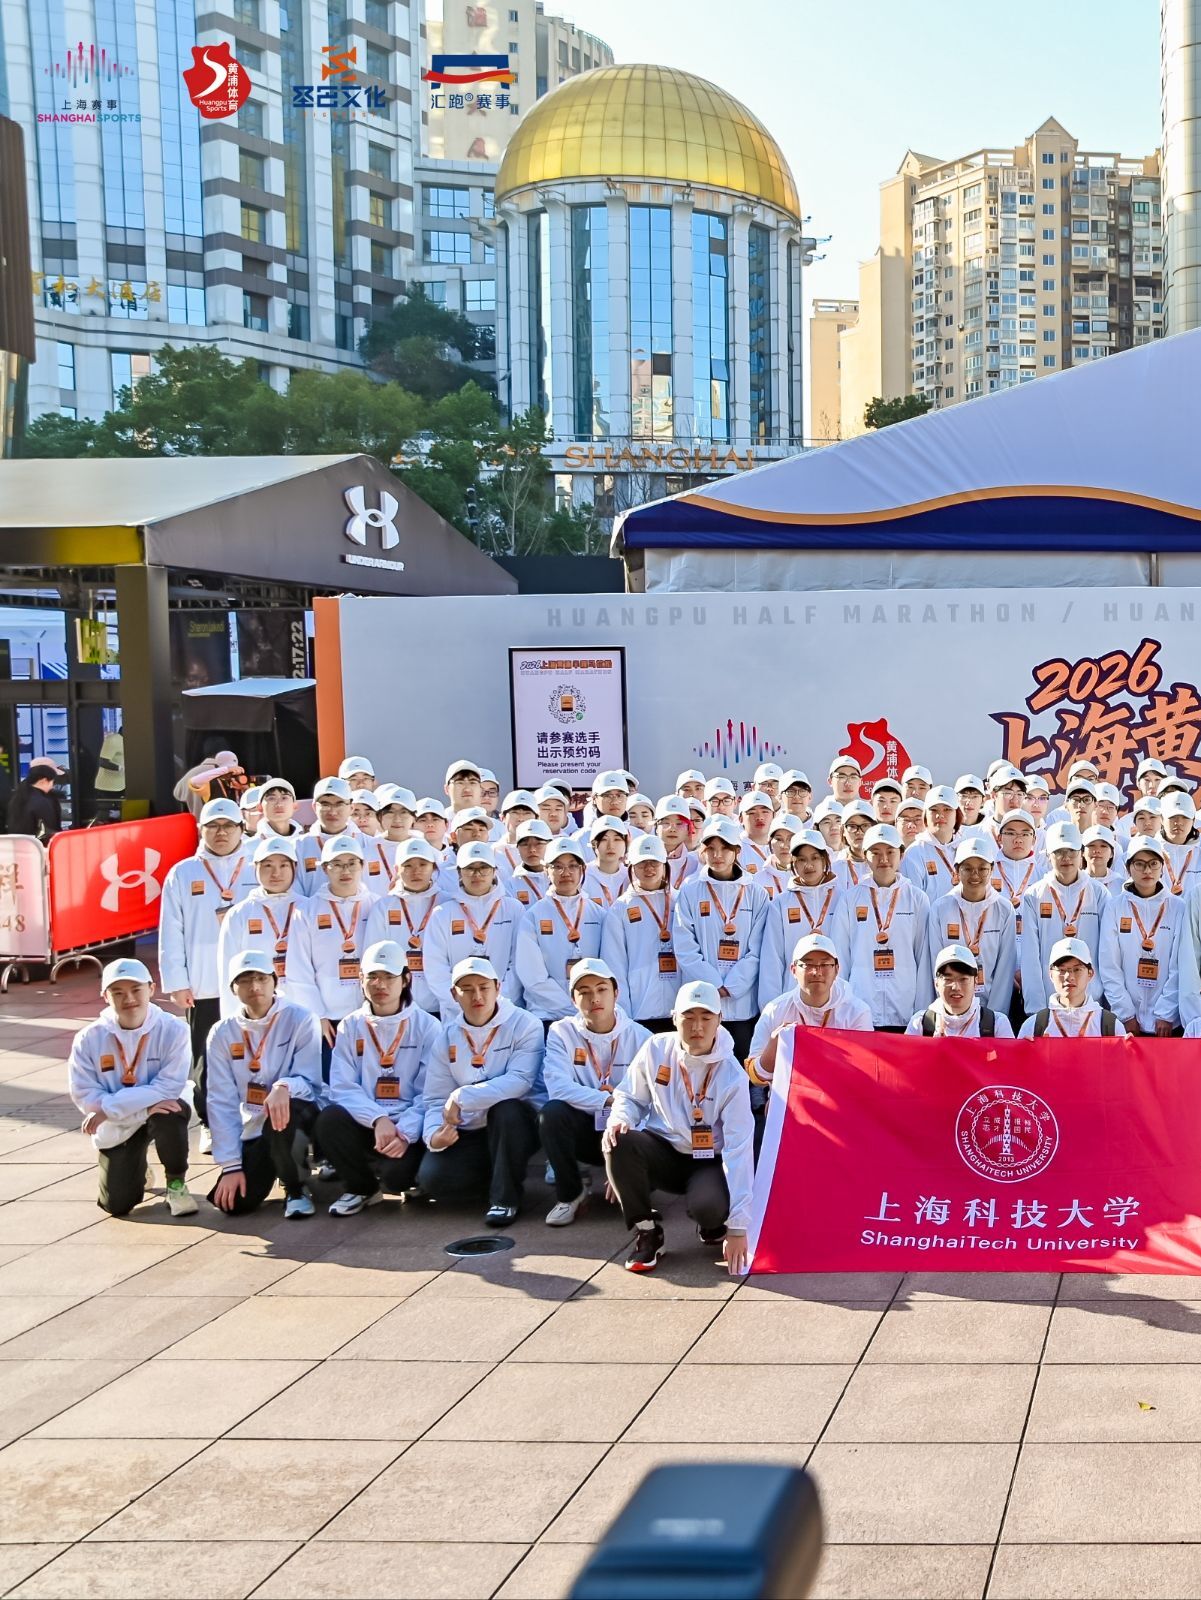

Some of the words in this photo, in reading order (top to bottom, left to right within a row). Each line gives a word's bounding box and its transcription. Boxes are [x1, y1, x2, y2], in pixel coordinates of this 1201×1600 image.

[564, 446, 753, 470] SHANGHAI
[547, 606, 708, 627] HUANGPU
[733, 605, 818, 626] HALF
[843, 603, 1036, 624] MARATHON
[1025, 638, 1163, 714] 2026
[536, 731, 601, 744] 请参赛选手
[537, 746, 601, 759] 出示预约码
[886, 740, 898, 779] 黄浦体
[961, 1130, 1014, 1177] SHANGHAITECH
[1016, 1135, 1053, 1176] UNIVERSITY
[863, 1191, 1141, 1229] 上海科技大学
[860, 1229, 1018, 1250] ShanghaiTech
[1027, 1236, 1140, 1251] University
